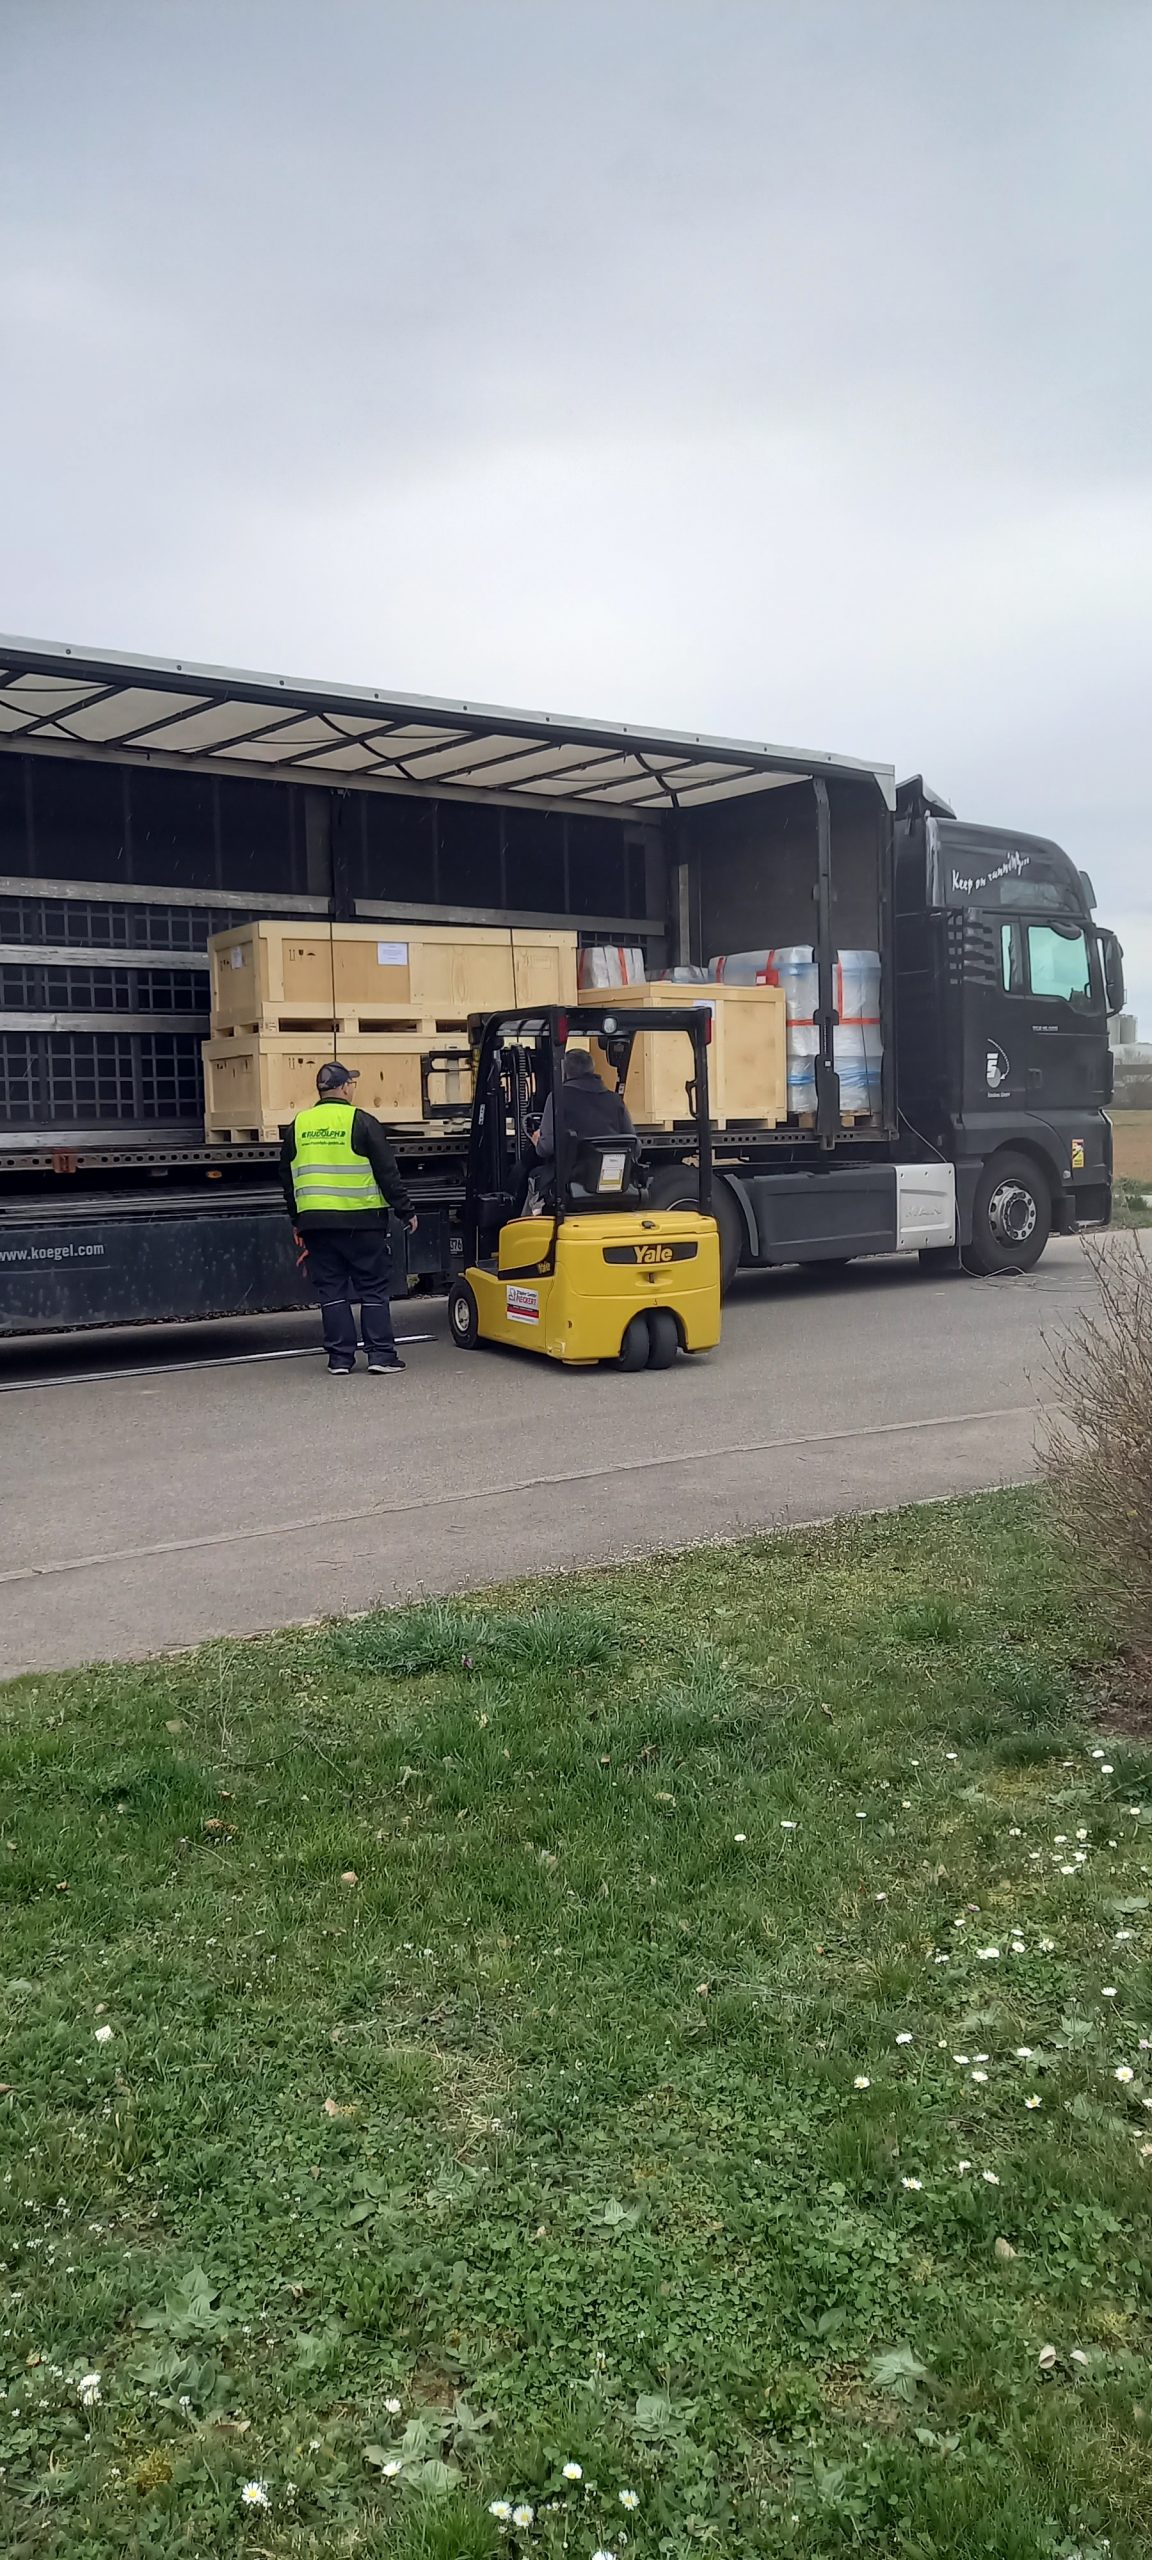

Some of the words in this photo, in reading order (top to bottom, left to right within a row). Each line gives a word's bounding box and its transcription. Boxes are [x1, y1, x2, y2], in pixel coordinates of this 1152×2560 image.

[952, 869, 973, 895] Keep
[975, 877, 986, 890] on
[0, 1243, 105, 1262] www.koegel.com
[633, 1244, 673, 1264] Yale
